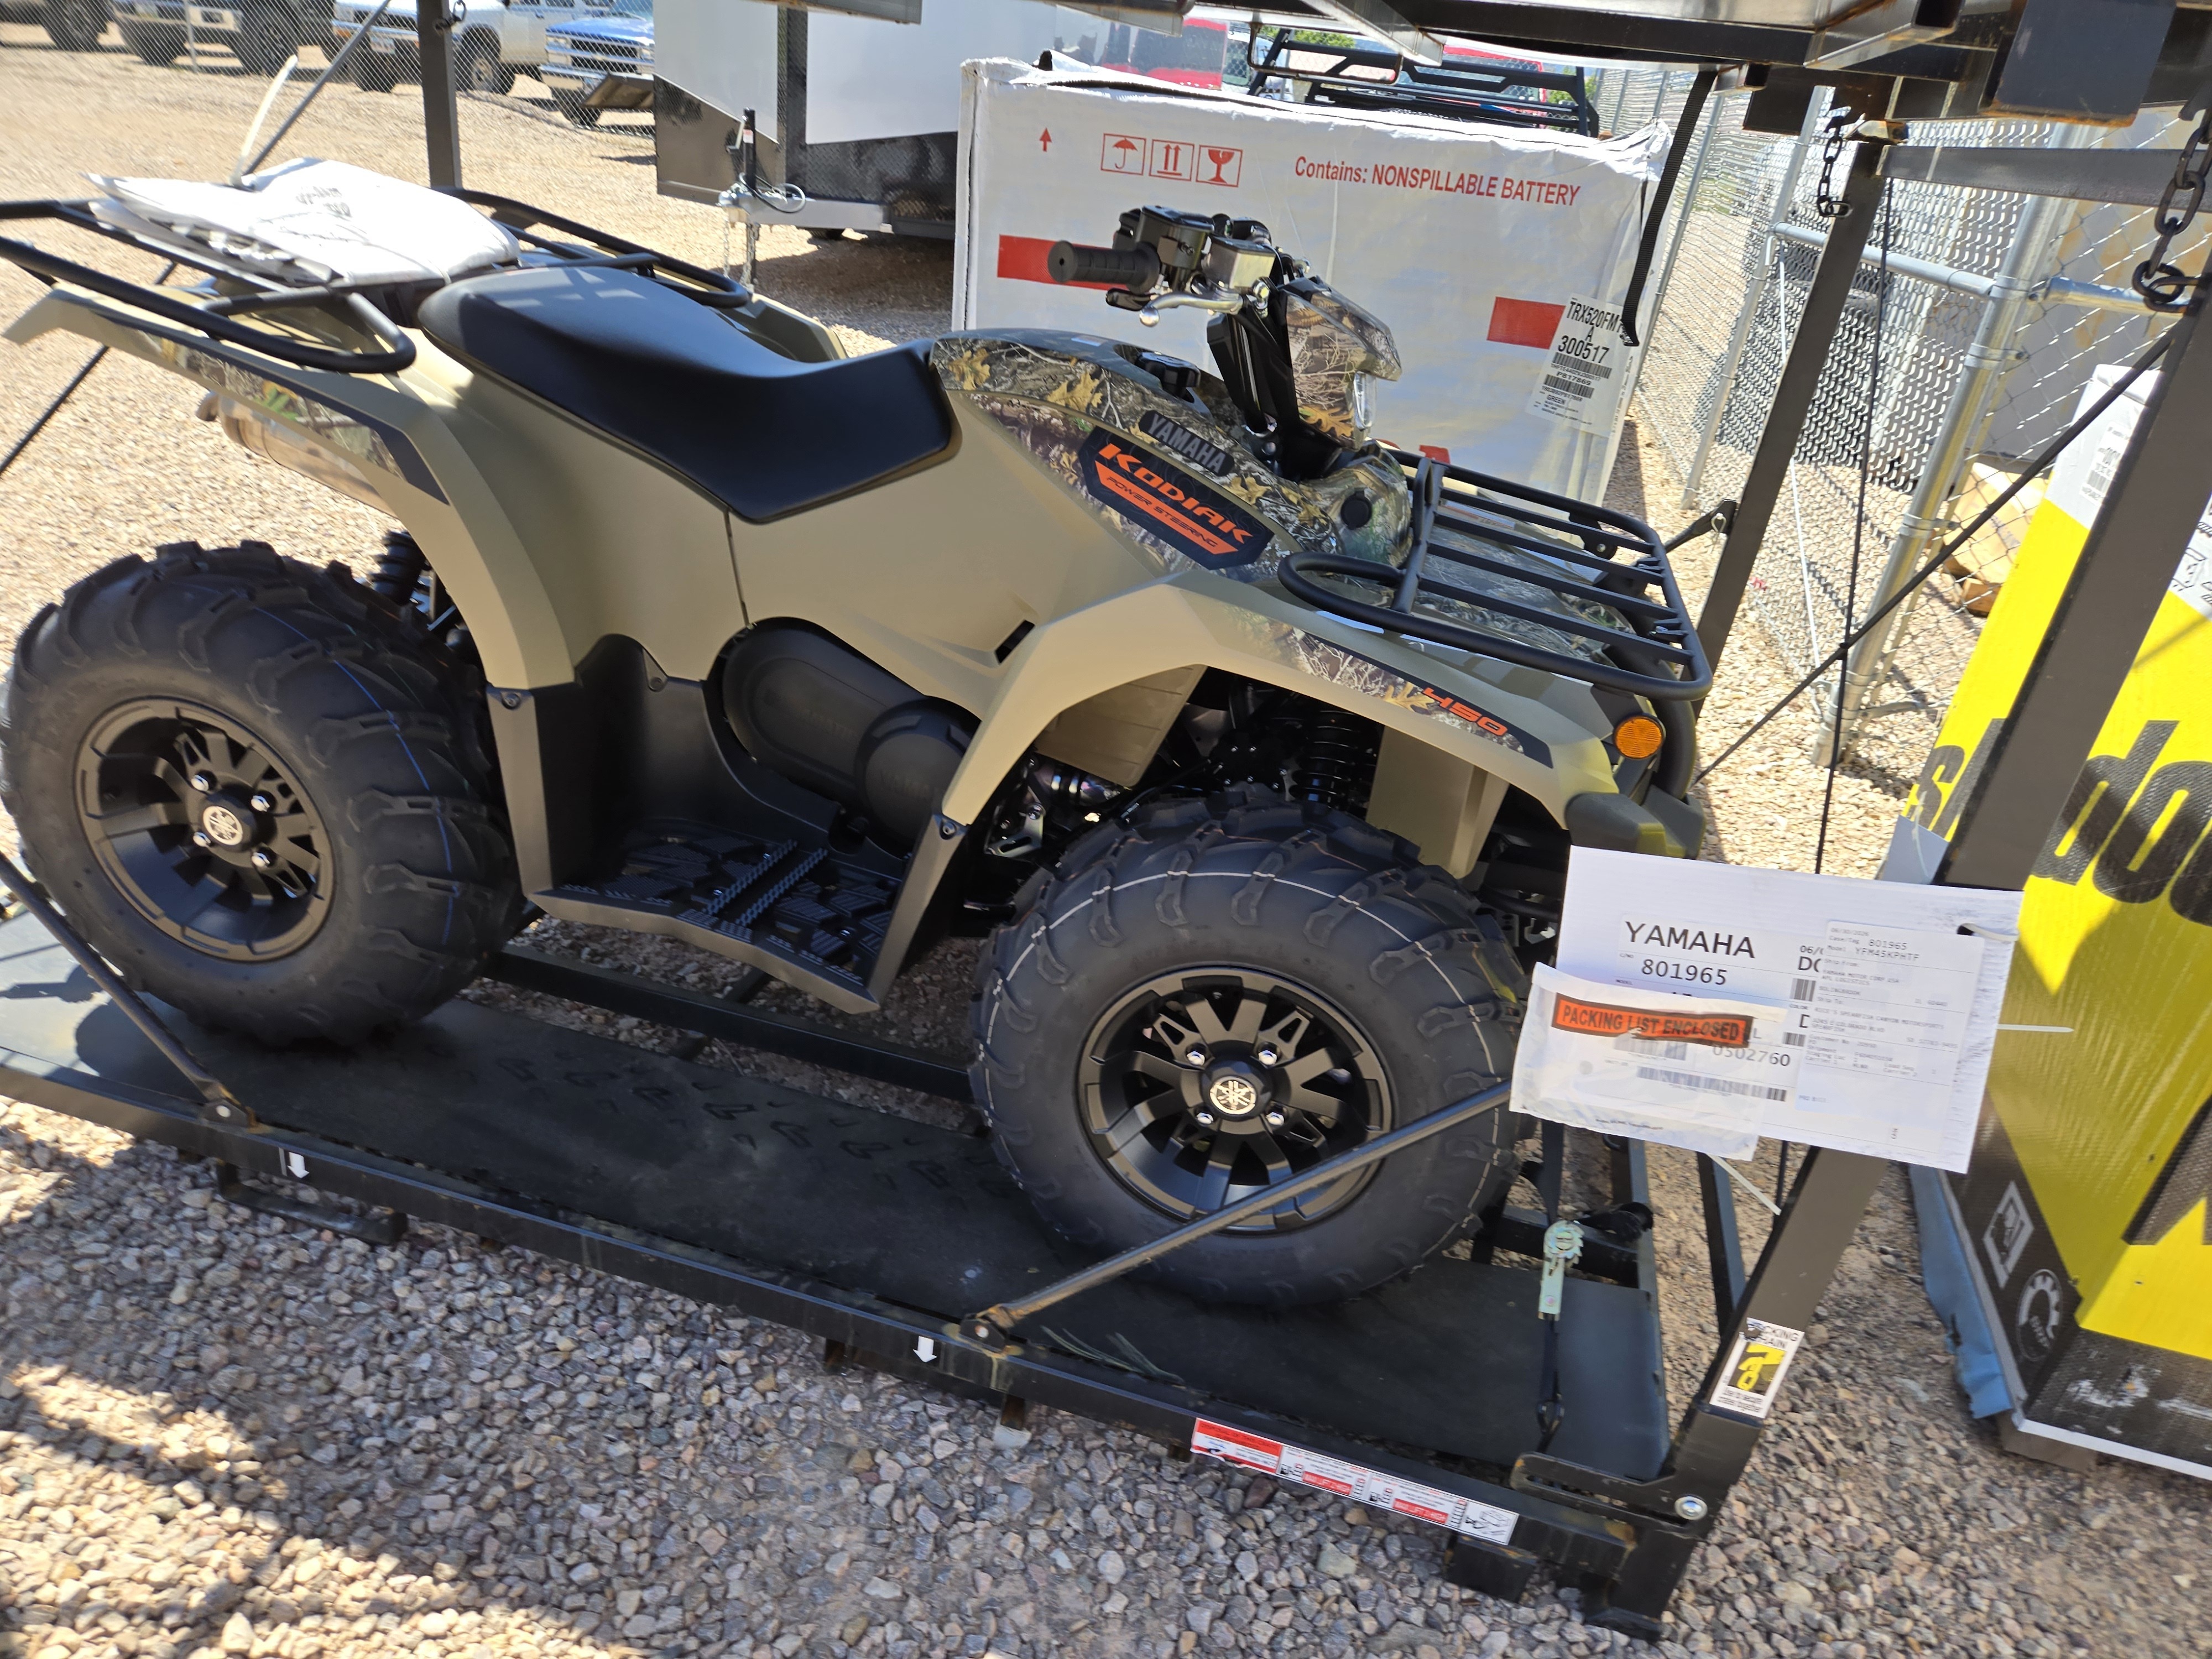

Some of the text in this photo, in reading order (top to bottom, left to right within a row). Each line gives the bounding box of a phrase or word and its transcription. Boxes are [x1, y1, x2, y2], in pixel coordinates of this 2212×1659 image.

[1295, 155, 1581, 206] Contains: NONSPILLABLE BATTERY
[1558, 335, 1610, 363] 300517
[1585, 326, 1594, 342] A
[1147, 414, 1227, 473] YAMAHA
[1098, 442, 1254, 544] KODIAK
[1106, 476, 1218, 547] POWER STEERING
[1422, 687, 1508, 737] 450
[1624, 920, 1756, 959] YAMAHA
[1855, 947, 1920, 961] YFM45KPHTF
[1869, 939, 1908, 950] 801965
[1641, 958, 1728, 986] 801965
[1562, 1004, 1740, 1041] PACKING LIST ENCLOSED
